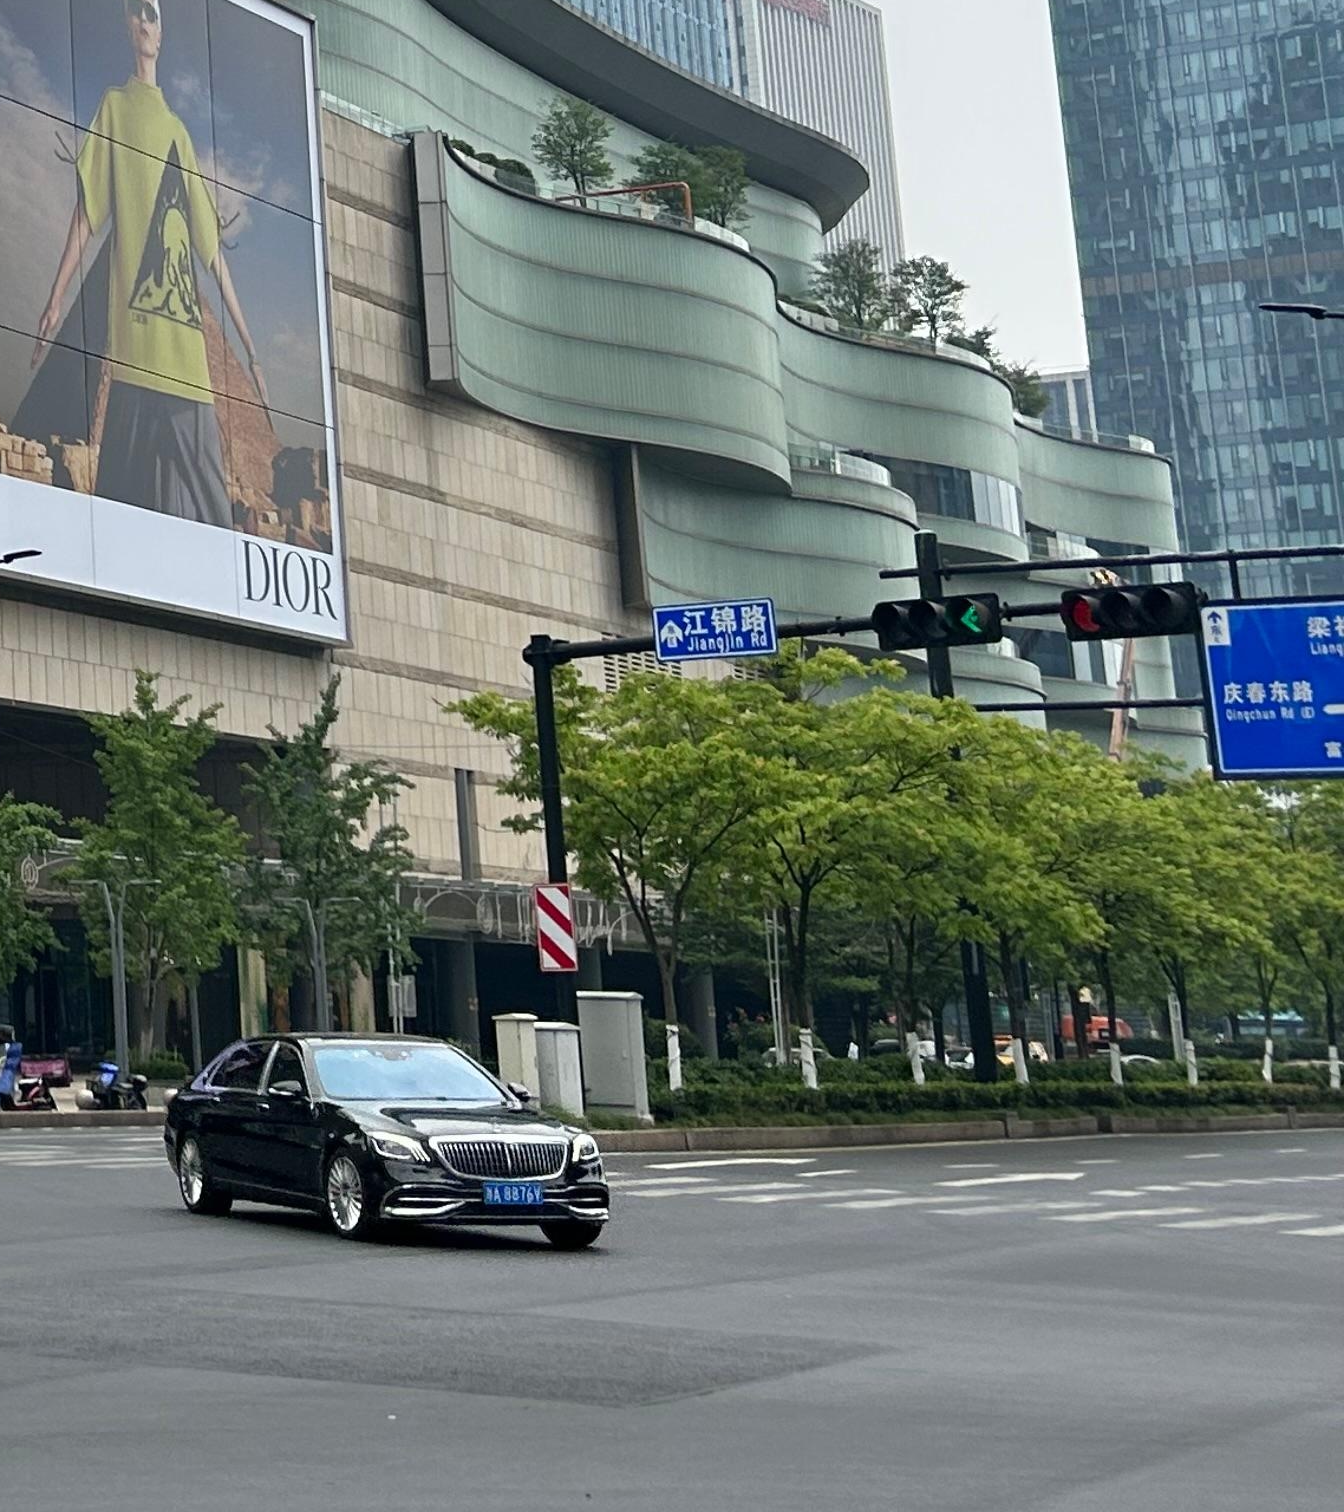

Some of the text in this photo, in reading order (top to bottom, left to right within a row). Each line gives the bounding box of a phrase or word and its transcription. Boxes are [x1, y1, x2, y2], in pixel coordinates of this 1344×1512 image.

[241, 539, 338, 620] DIOR
[683, 605, 767, 637] 江锦路
[687, 632, 745, 653] Jiangjin
[750, 630, 768, 647] Rd
[1223, 680, 1313, 705] 庆春东路
[1226, 707, 1276, 723] Qingchun
[1280, 706, 1295, 719] Rd
